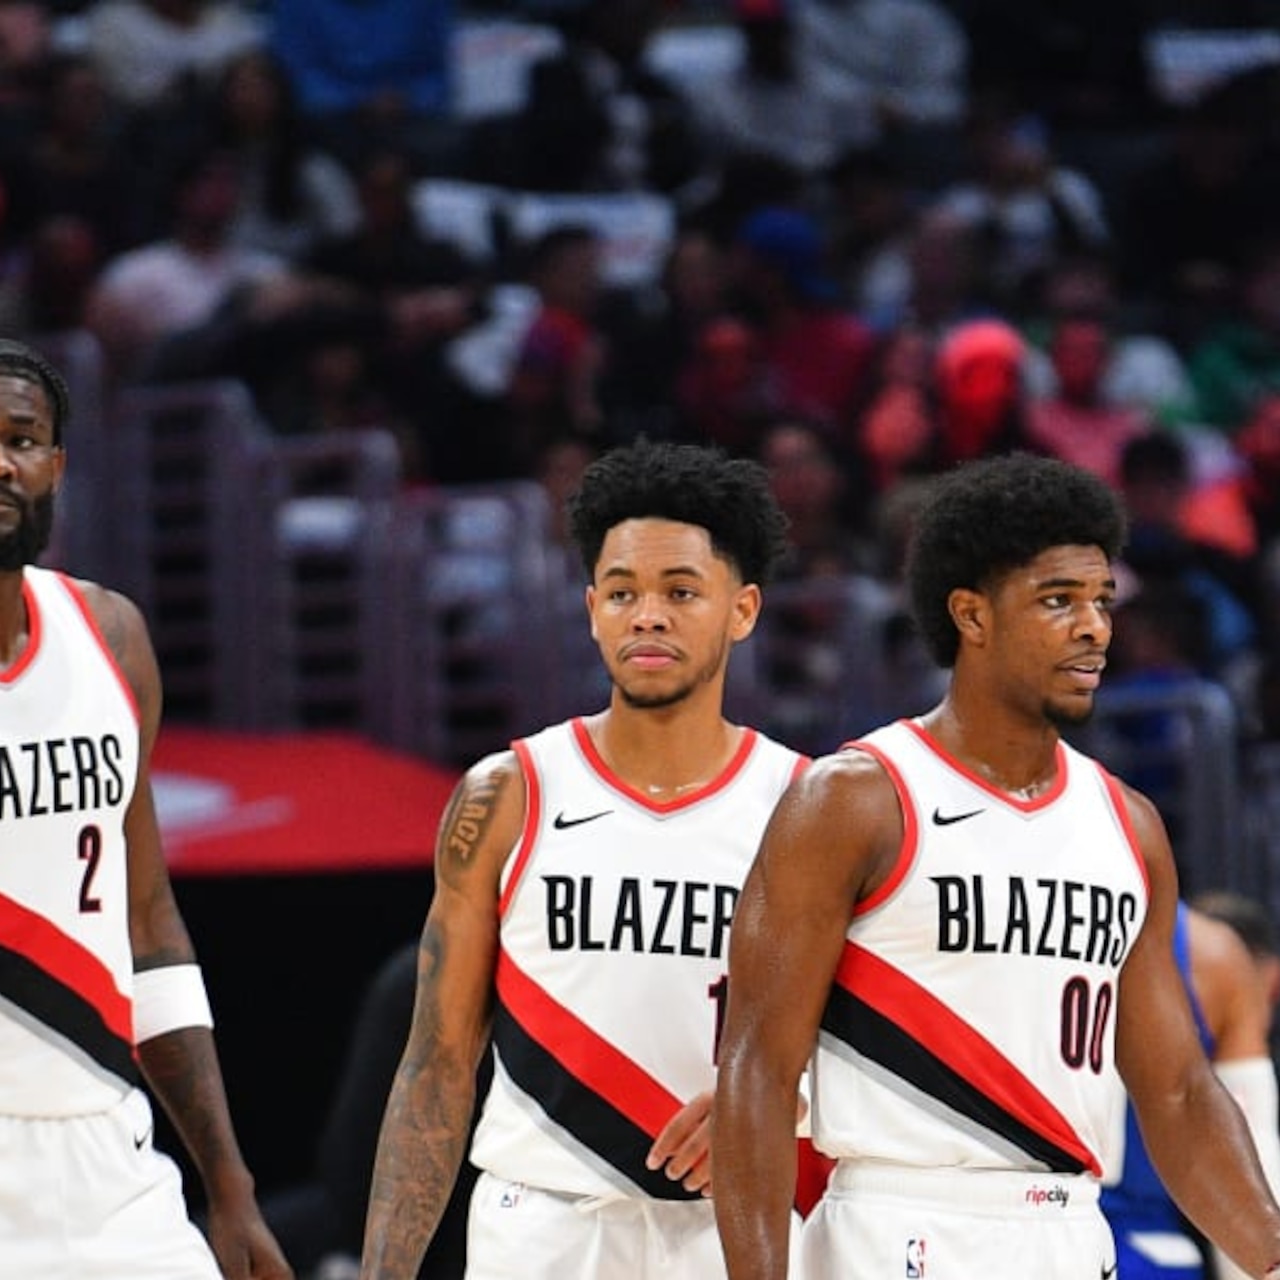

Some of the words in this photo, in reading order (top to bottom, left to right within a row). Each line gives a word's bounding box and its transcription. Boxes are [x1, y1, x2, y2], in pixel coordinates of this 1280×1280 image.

[77, 824, 102, 914] 2
[540, 874, 741, 959] BLAZER
[928, 874, 1136, 969] BLAZERS
[1060, 975, 1113, 1076] 00
